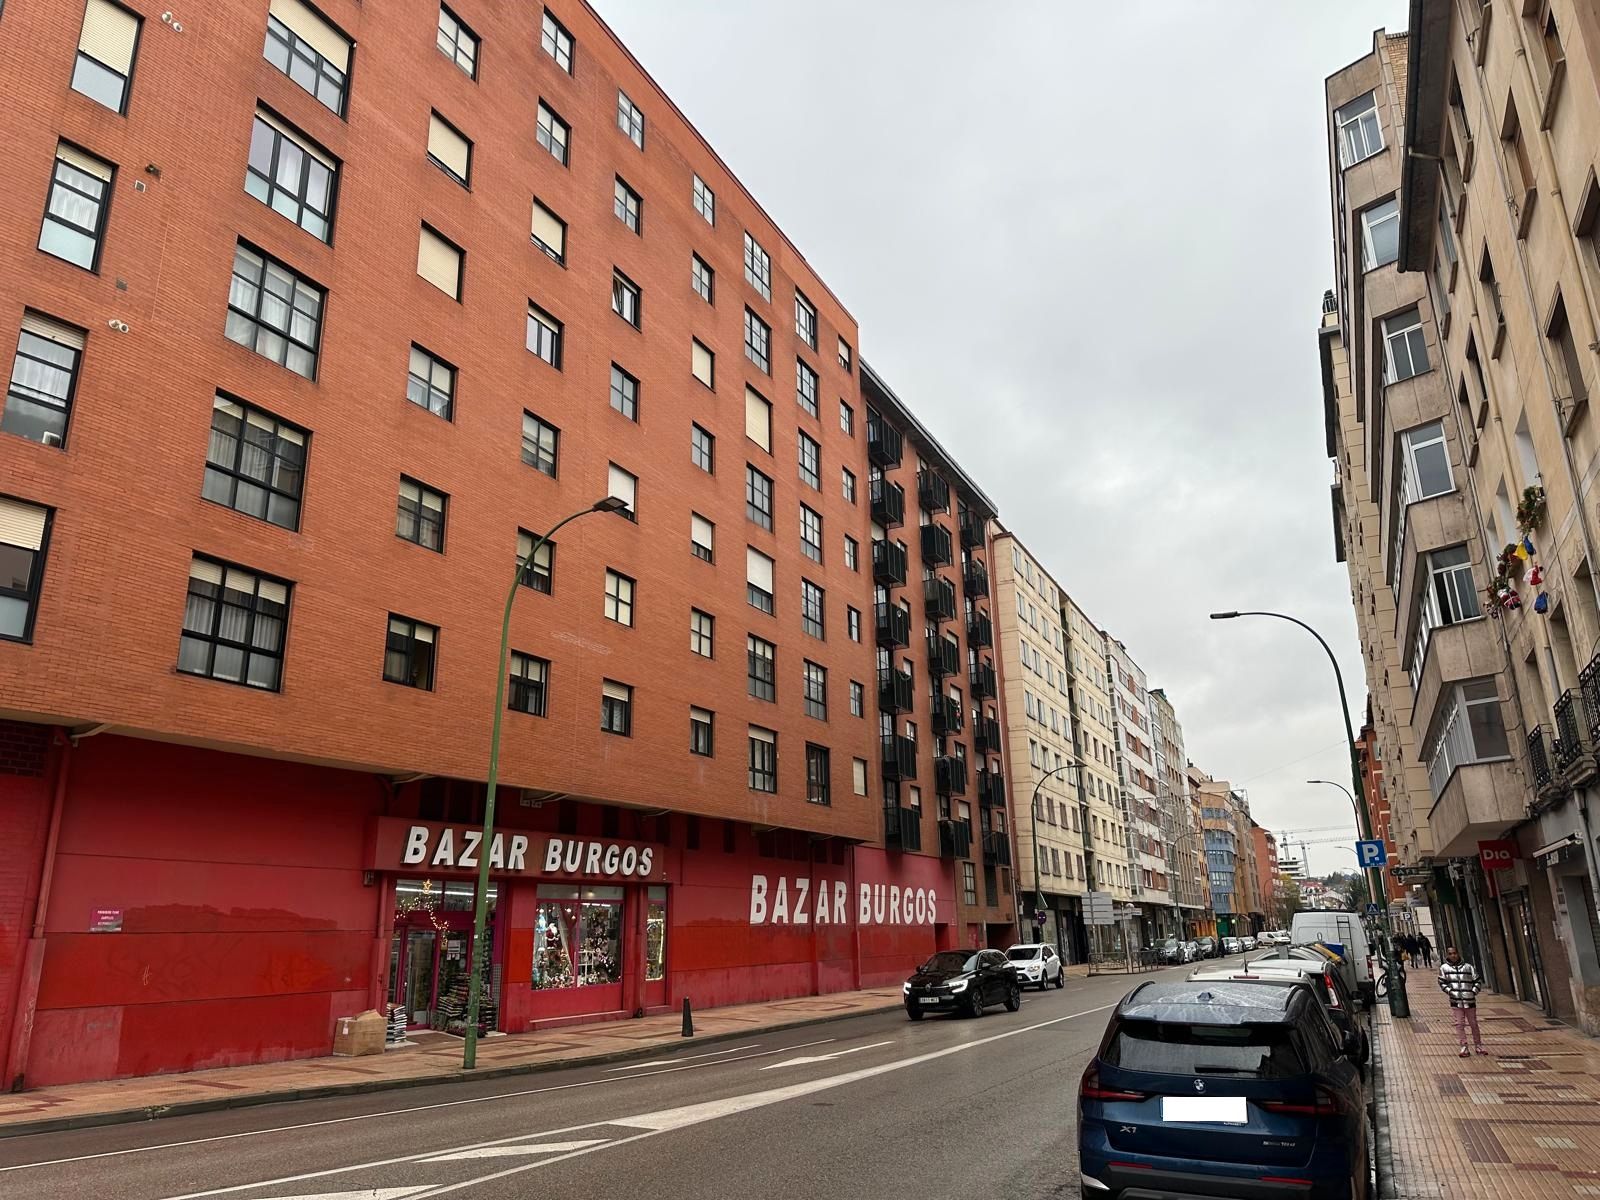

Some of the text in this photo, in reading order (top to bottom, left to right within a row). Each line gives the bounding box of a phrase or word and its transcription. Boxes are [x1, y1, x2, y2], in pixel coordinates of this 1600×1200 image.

[404, 826, 653, 876] BAZAR BURGOS
[750, 875, 937, 925] BAZAR BURGOS
